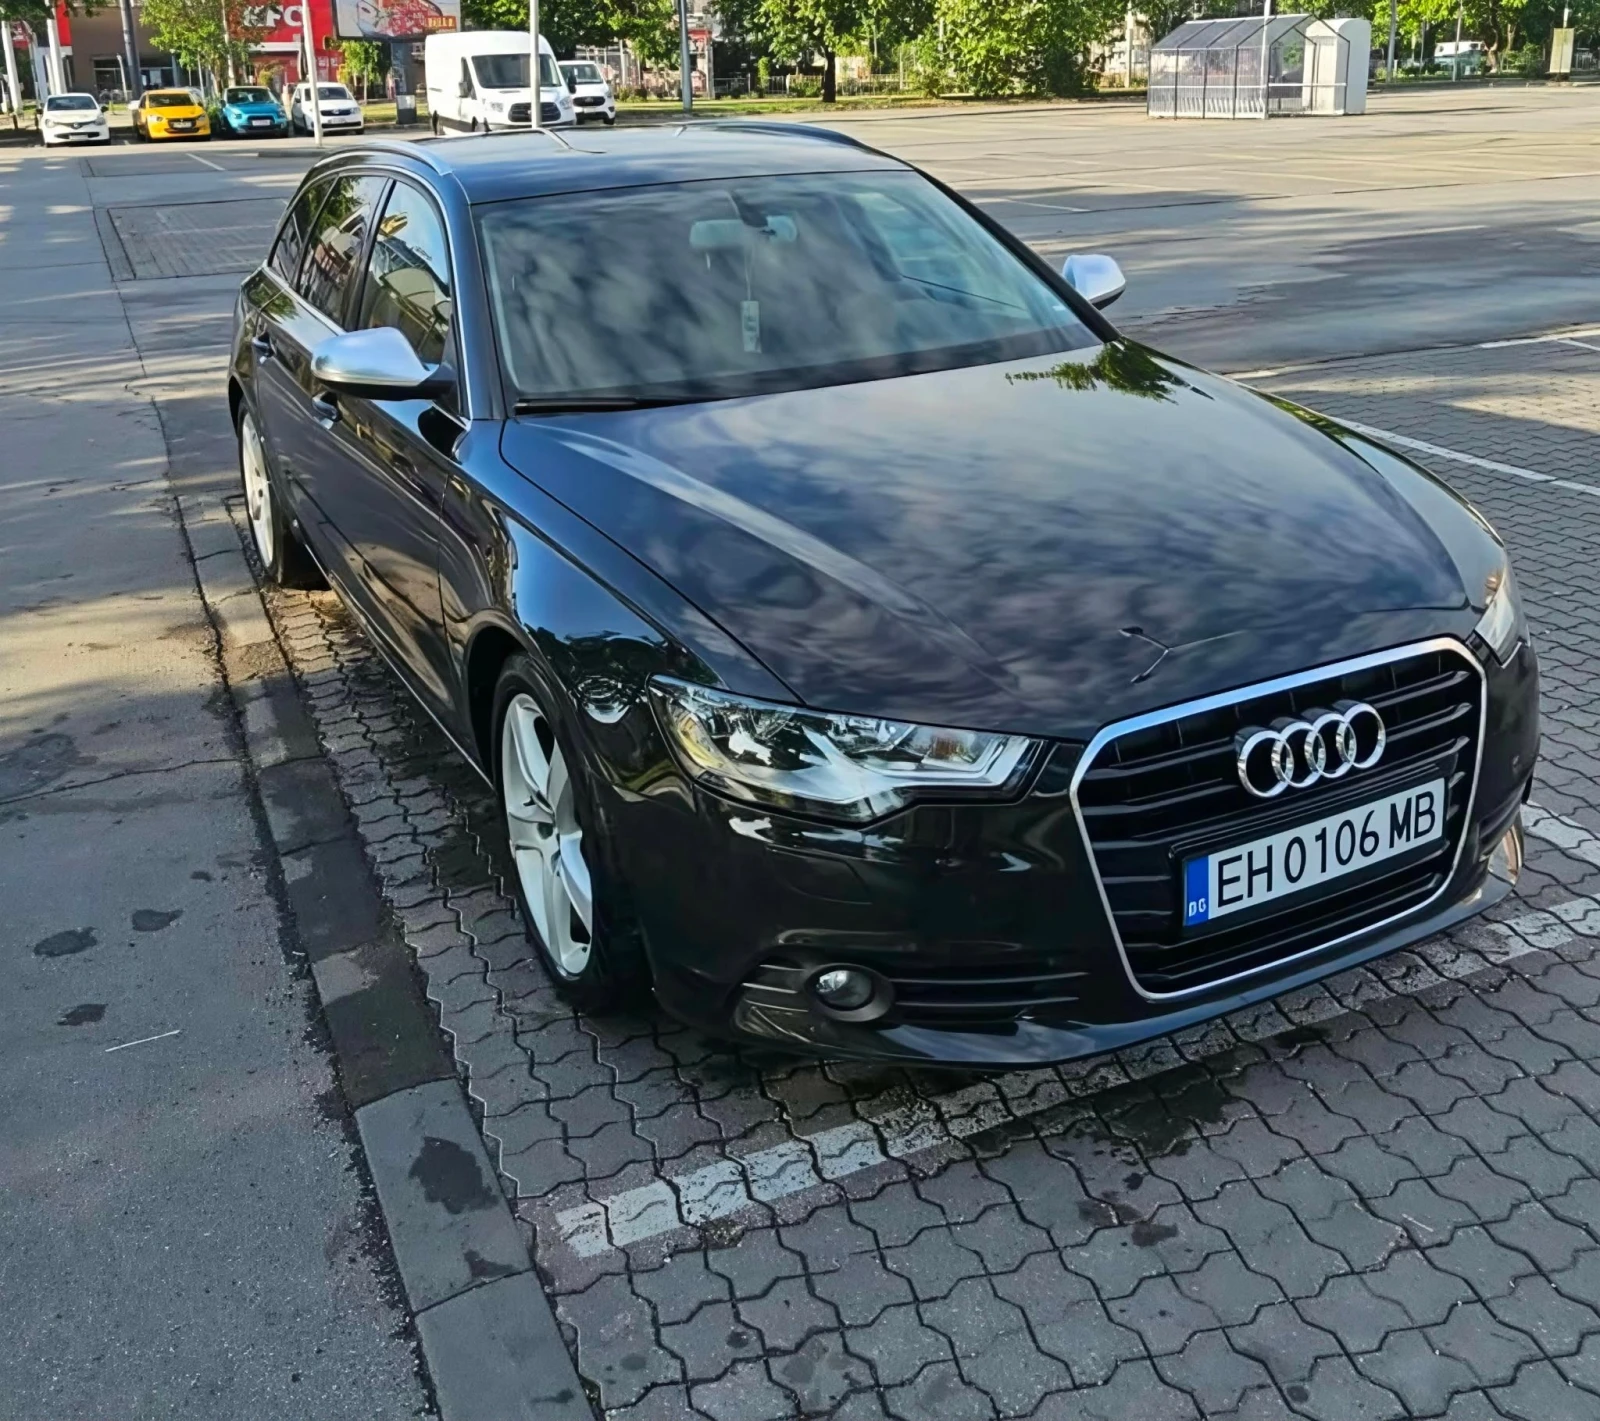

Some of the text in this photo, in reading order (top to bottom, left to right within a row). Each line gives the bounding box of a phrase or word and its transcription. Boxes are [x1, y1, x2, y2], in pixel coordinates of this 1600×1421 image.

[1217, 791, 1436, 908] EH 0106 MB
